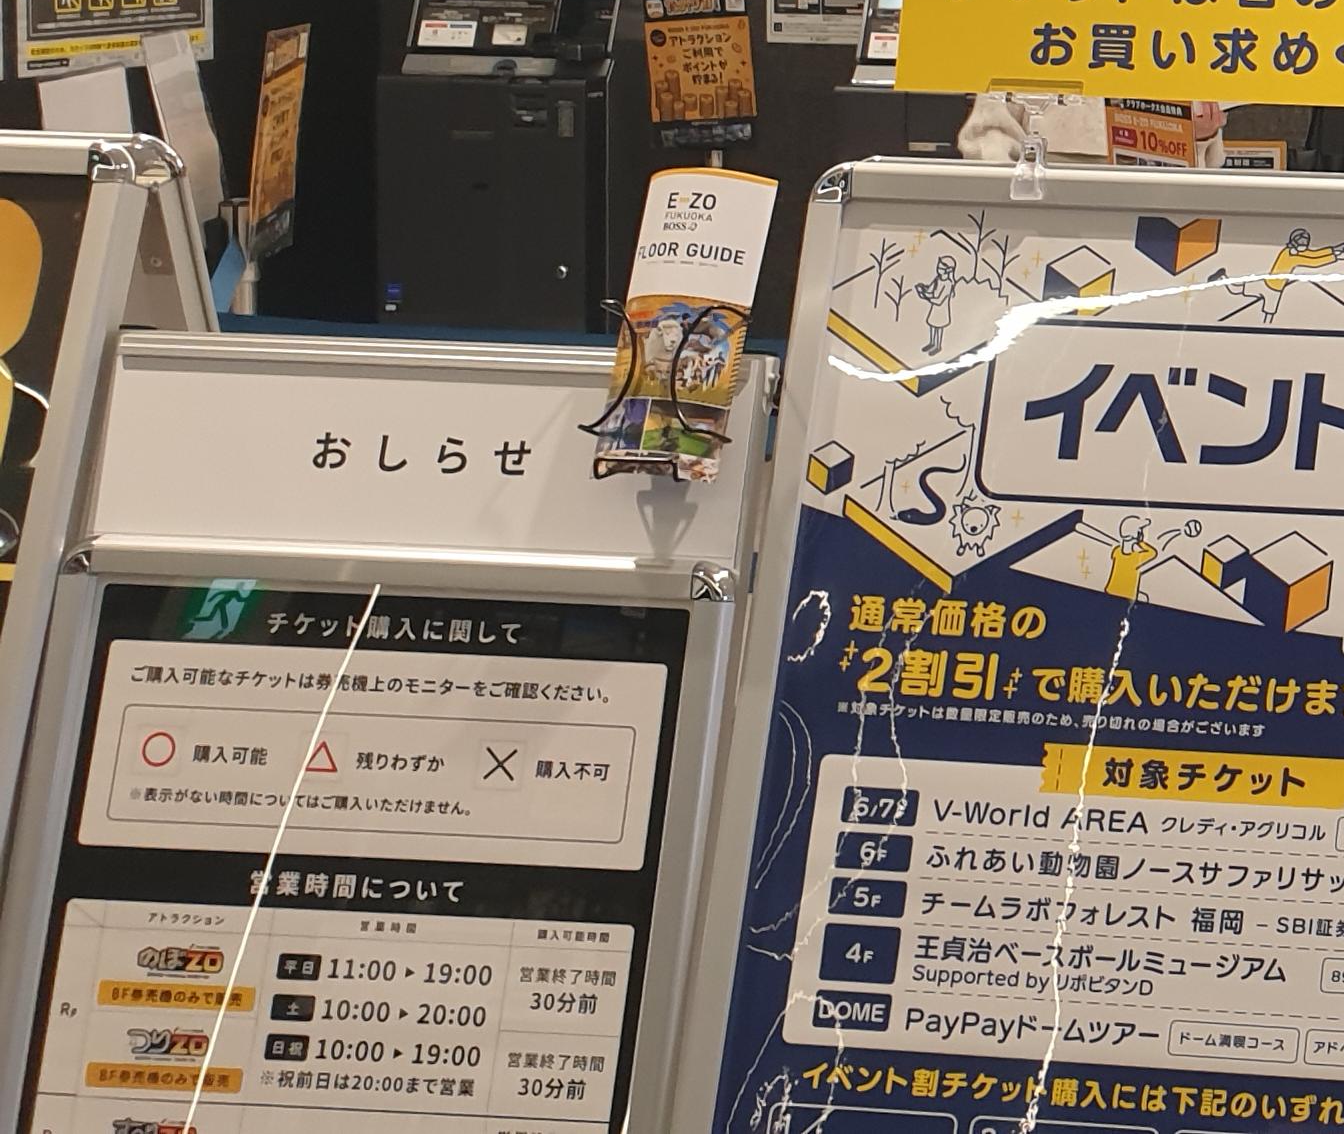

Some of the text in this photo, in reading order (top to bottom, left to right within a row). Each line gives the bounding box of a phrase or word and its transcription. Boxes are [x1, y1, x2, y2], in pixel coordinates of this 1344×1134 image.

[687, 243, 745, 265] GUIDE
[313, 430, 532, 476] おしらせ
[267, 612, 522, 645] チケット購入に関して
[850, 595, 1046, 639] 通常価格の
[194, 744, 610, 782] 購入可能 残りわずか 購入不可
[1104, 755, 1306, 798] 対象チケット
[934, 799, 1326, 842] V-World AREA クレディ・アグリコル
[250, 870, 465, 903] 営業時間について
[854, 887, 881, 907] 5F
[921, 892, 1175, 929] チームラボフォレスト
[1192, 907, 1244, 934] 福岡
[328, 958, 397, 982] 11:00
[423, 963, 492, 987] 19:00
[846, 936, 1286, 982] 4F 王貞治ベースボールミュージアム
[519, 966, 617, 988] 営業終了時間
[912, 966, 1019, 989] Supported
[1026, 974, 1049, 992] by
[321, 999, 486, 1028] 10:00 20:00
[530, 991, 598, 1014] 30分前
[817, 998, 1159, 1045] DOME PayPayドームツアー
[315, 1038, 384, 1063] 10:00
[412, 1042, 480, 1067] 19:00
